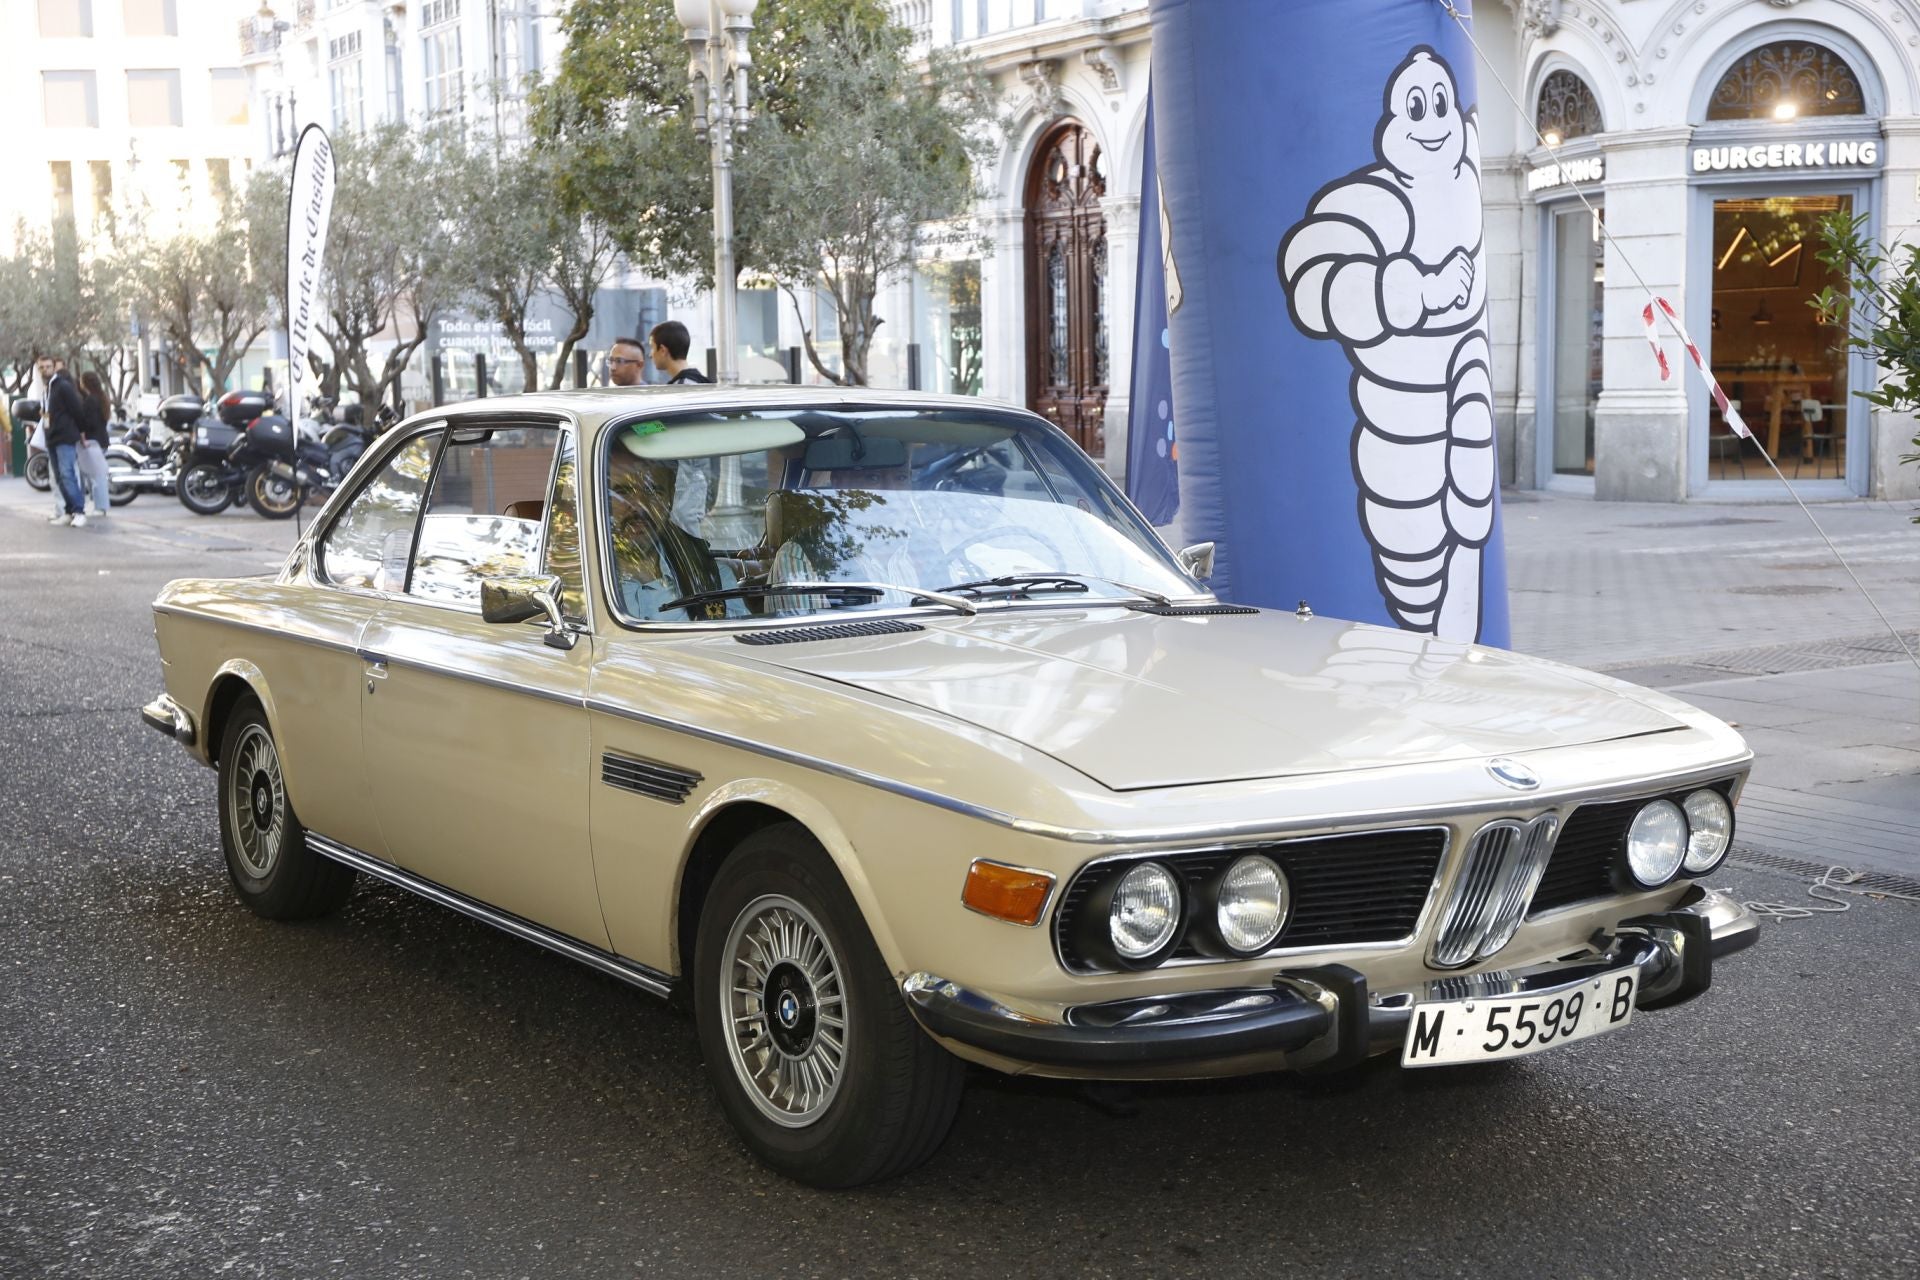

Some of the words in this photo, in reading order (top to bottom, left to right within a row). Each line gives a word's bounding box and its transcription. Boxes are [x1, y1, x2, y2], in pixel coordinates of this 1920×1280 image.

[1561, 157, 1602, 184] KING
[1692, 144, 1803, 172] BURGER
[1805, 141, 1877, 167] KING
[305, 139, 329, 239] Castilla
[302, 239, 317, 269] de
[293, 270, 312, 342] Norte
[438, 320, 471, 332] Todo
[474, 322, 490, 332] es
[440, 334, 488, 347] cuando
[292, 345, 304, 384] El
[1482, 991, 1584, 1052] 5599
